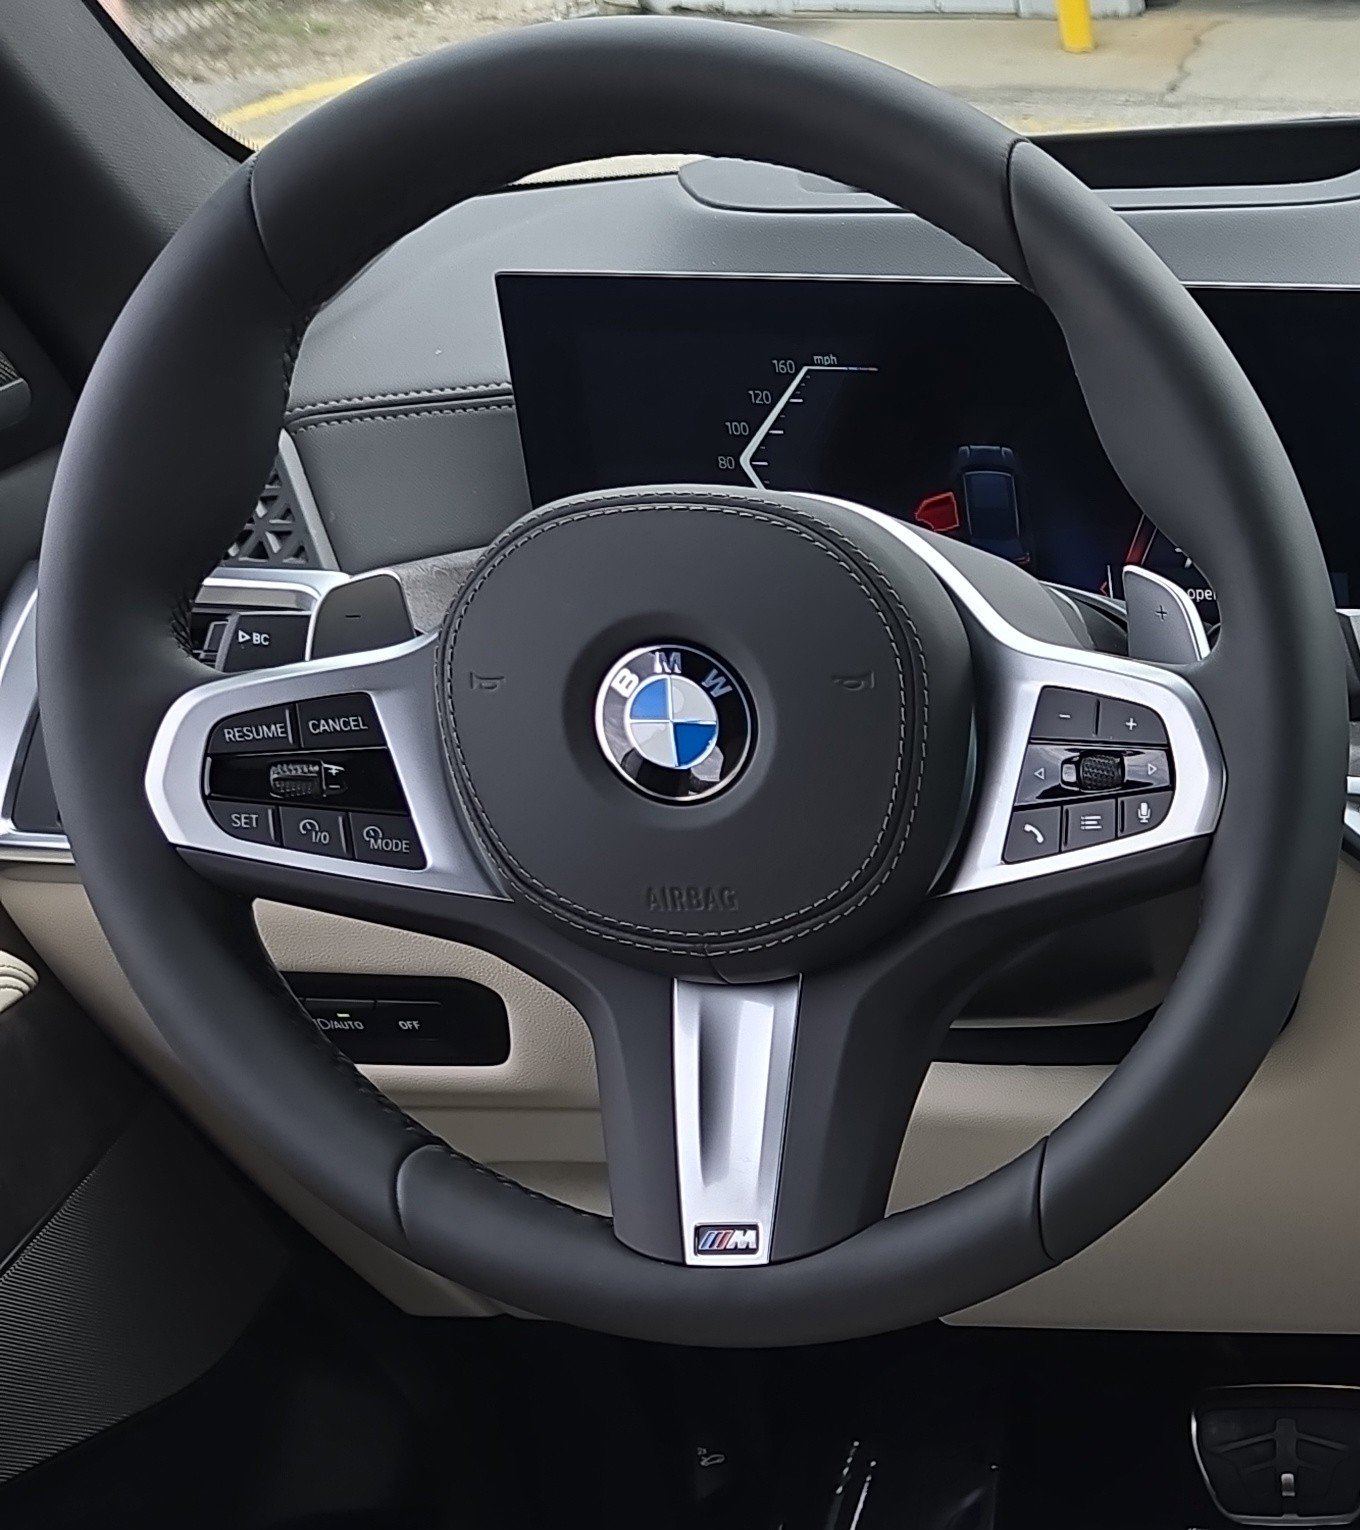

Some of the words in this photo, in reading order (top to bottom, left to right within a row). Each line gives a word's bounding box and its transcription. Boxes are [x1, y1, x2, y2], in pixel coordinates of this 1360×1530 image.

[813, 354, 838, 365] mph
[772, 360, 796, 374] 160
[748, 390, 772, 404] 120
[725, 422, 750, 436] 100
[717, 456, 735, 470] 80
[252, 632, 270, 645] BC
[610, 651, 733, 698] BMW
[308, 716, 368, 734] CANCEL
[224, 723, 287, 742] RESUME
[231, 813, 259, 828] SET
[369, 838, 410, 852] MODE
[644, 885, 739, 912] AIRBAG
[398, 1020, 421, 1030] OFF
